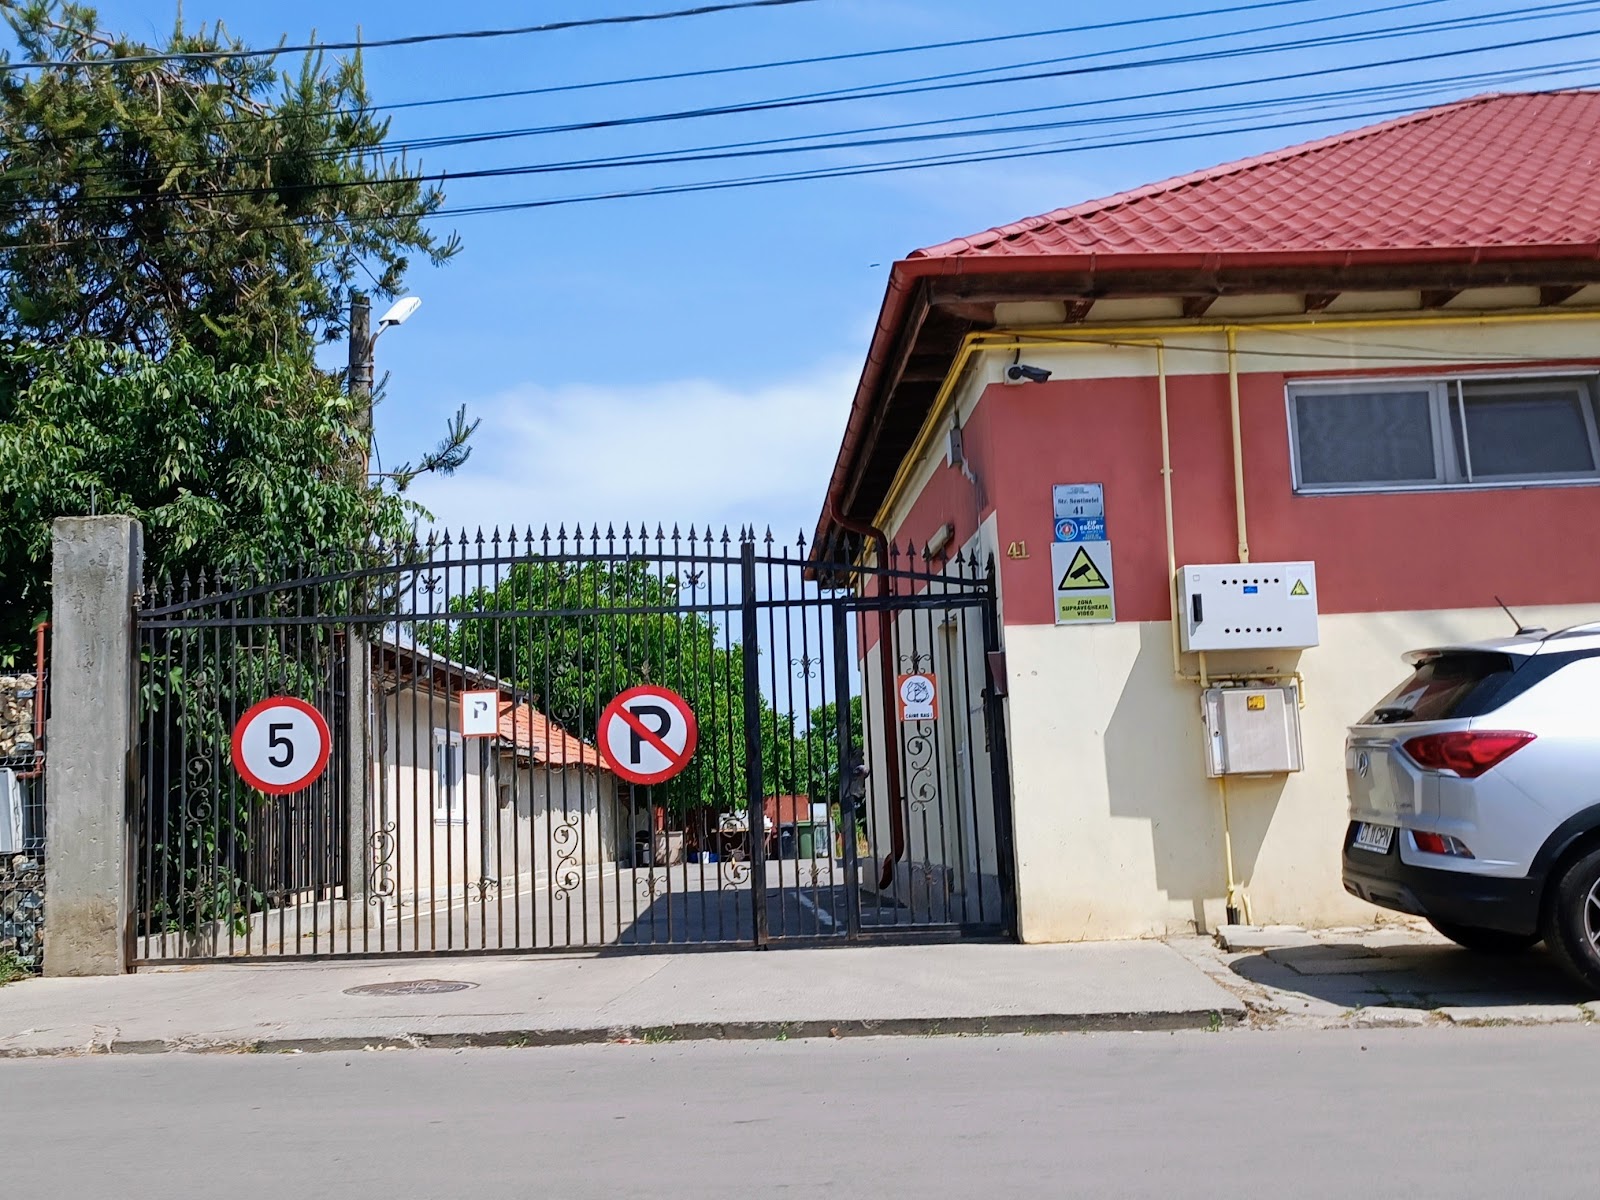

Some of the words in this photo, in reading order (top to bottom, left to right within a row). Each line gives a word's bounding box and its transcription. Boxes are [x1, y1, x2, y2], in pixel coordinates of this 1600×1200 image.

[1073, 506, 1083, 515] 41
[1007, 541, 1030, 559] 41
[268, 723, 294, 768] 5
[630, 705, 671, 764] P
